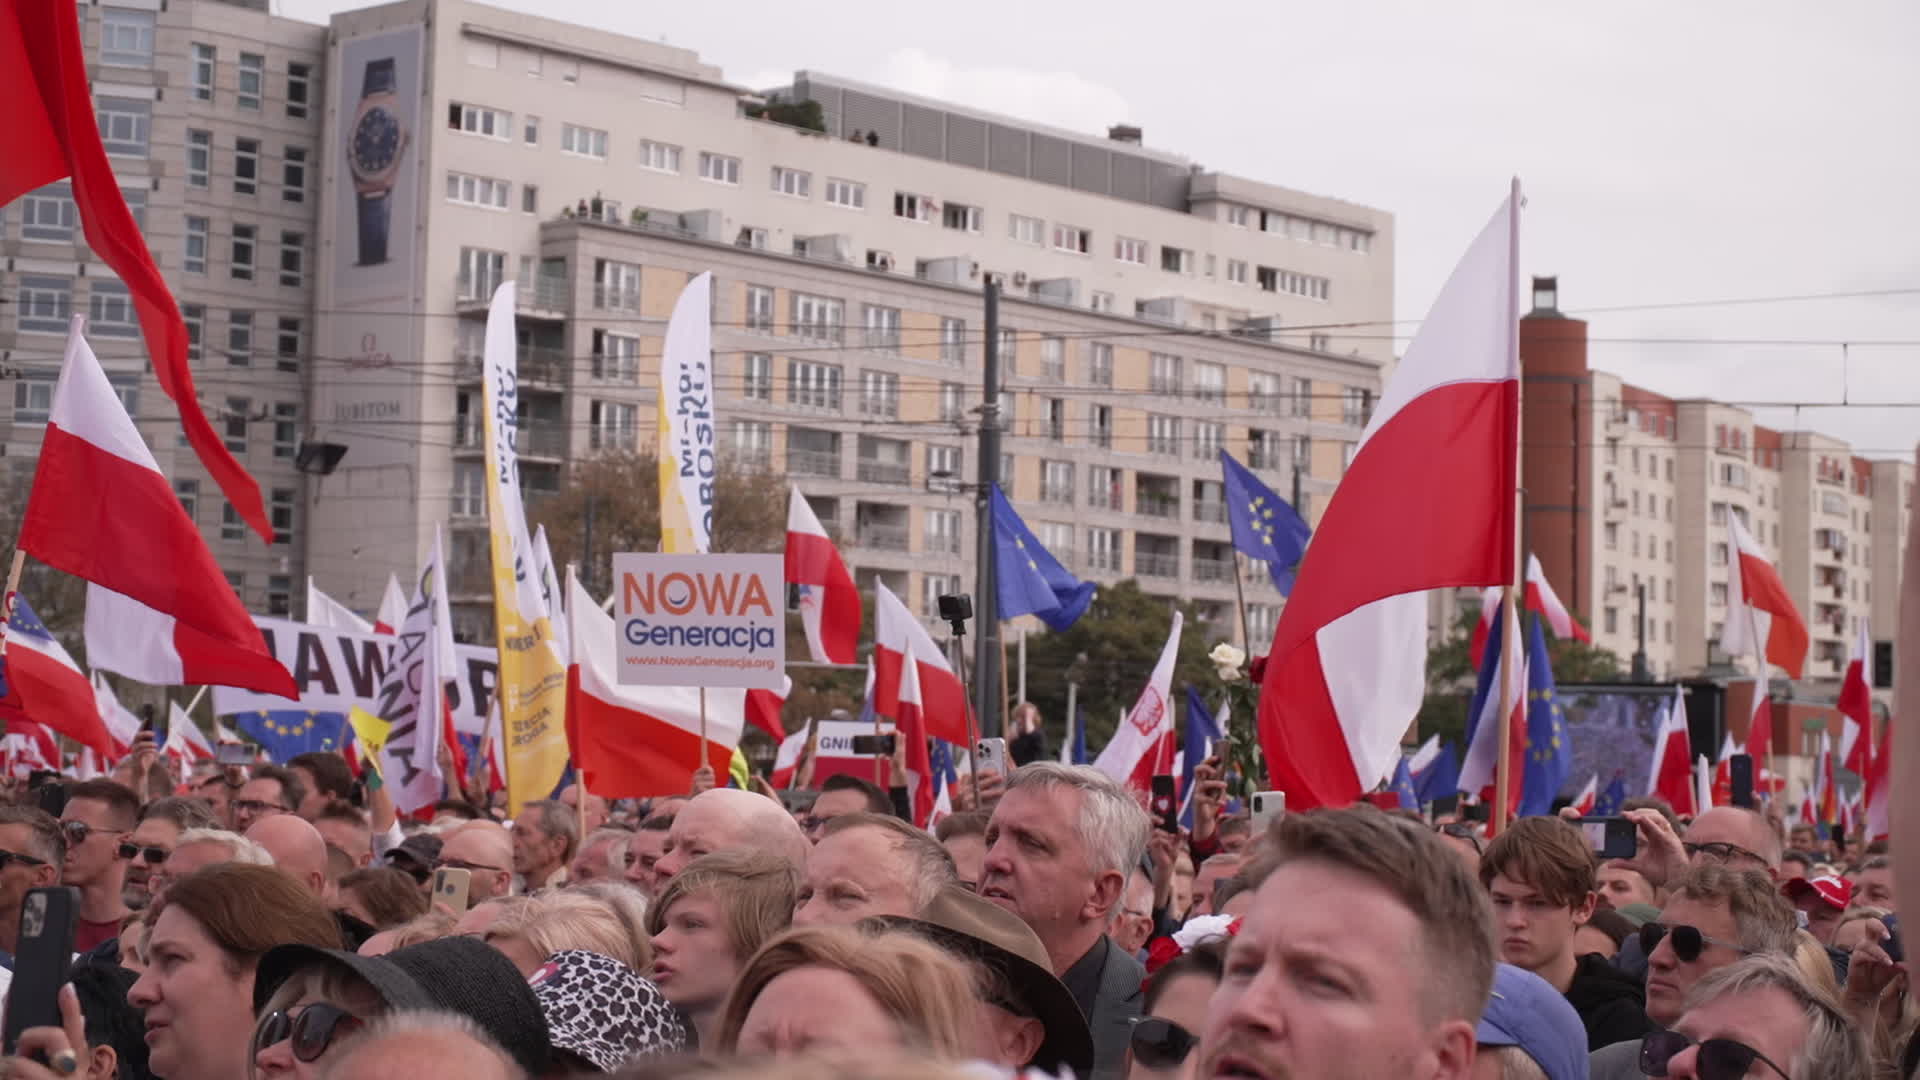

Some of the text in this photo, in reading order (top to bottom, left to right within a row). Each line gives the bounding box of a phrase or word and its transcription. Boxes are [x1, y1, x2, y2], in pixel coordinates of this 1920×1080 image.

[623, 572, 774, 616] NOWA
[625, 618, 775, 653] Generacja
[625, 655, 775, 671] www.NowaGeneracja.org
[820, 736, 855, 750] GNI
